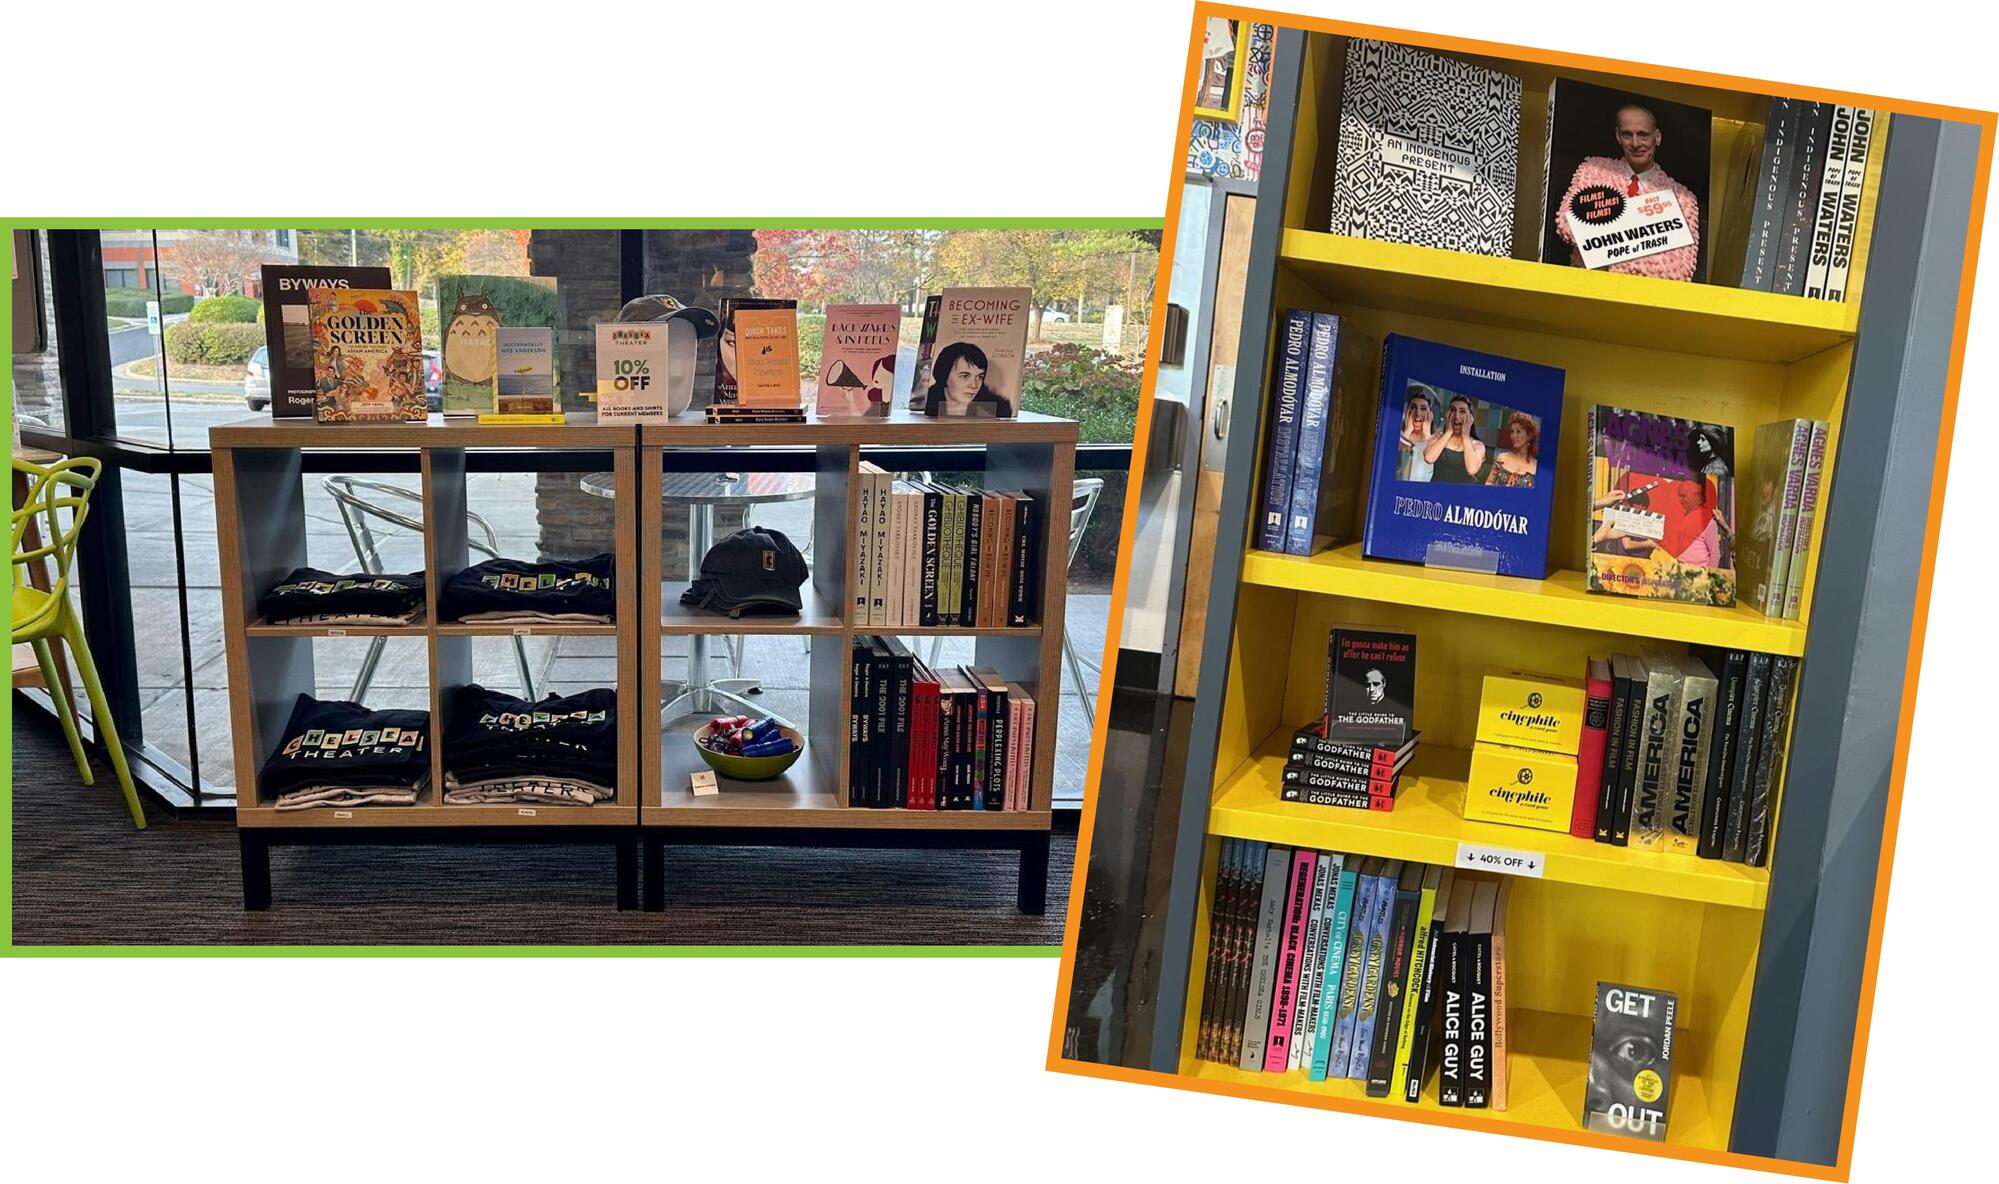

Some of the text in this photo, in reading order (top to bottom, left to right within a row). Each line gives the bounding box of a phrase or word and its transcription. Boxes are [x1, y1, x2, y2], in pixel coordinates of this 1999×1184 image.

[1388, 139, 1472, 166] AN INDIGENOUS
[1402, 154, 1455, 174] PRESENT
[1580, 192, 1604, 204] FILMS!
[1812, 108, 1850, 266] JOHN WATERS
[1832, 109, 1870, 269] JOHN WATERS
[1586, 209, 1611, 220] FILMS!
[1594, 198, 1619, 209] FILMS!
[1755, 121, 1784, 284] INDIGENOUS PRESENT
[1784, 128, 1814, 291] INDIGENOUS PRESENT
[1582, 218, 1683, 252] JOHN WATERS
[1607, 236, 1668, 258] POPE TRASH
[279, 278, 349, 290] BYWAYS
[949, 300, 1021, 312] BECOMING
[962, 314, 1014, 325] EX-WIFE
[328, 316, 403, 330] GOLDEN
[330, 330, 402, 344] SCREEN
[1287, 320, 1304, 354] PEDRO
[614, 360, 650, 374] 10%
[1306, 323, 1331, 427] PEDRO ALMODÓVAR
[1460, 365, 1506, 382] INSTALLATION
[614, 376, 650, 391] OFF
[1280, 358, 1300, 423] ALMODÓVAR
[288, 396, 314, 405] Roger
[1784, 468, 1802, 509] VARDA
[1802, 470, 1820, 513] VARDA
[971, 504, 980, 537] NOBODY'S
[1394, 496, 1528, 535] PEDRO ALMODÓVAR
[926, 509, 938, 555] GOLDEN
[941, 500, 953, 569] GHIBLIOTHEQUE
[953, 500, 966, 569] GHIBLIOTHEQUE
[859, 531, 867, 586] MIYAZAKI
[877, 531, 885, 586] MIYAZAKI
[924, 557, 936, 599] SCREEN
[1602, 573, 1640, 588] DIRECTOR'S
[1344, 649, 1360, 658] offer
[1361, 651, 1369, 659] he
[1351, 640, 1370, 649] gonna
[1389, 642, 1400, 650] him
[879, 696, 887, 716] 2001
[1726, 676, 1738, 726] Vampire Cinema
[1356, 716, 1404, 725] GODFATHER
[1500, 710, 1560, 728] cinephile
[1749, 706, 1757, 729] Cinema
[283, 728, 419, 754] CHELSEA
[942, 737, 950, 751] May
[1608, 697, 1625, 769] FASHION IN FILM
[1625, 699, 1642, 770] FASHION IN FILM
[291, 747, 402, 759] THEATER
[939, 751, 949, 770] Wong
[993, 720, 1003, 792] PERPLEXING PLOTS
[1317, 743, 1371, 760] GODFATHER
[1638, 694, 1672, 828] AMERICA
[1672, 697, 1704, 834] AMERICA
[1314, 759, 1369, 776] GODFATHER
[1309, 776, 1366, 792] GODFATHER
[1489, 787, 1551, 804] cinephile
[1310, 794, 1368, 808] GODFATHER
[1480, 854, 1523, 867] 40% OFF
[1268, 899, 1276, 916] Andy
[1292, 862, 1308, 924] REGENERATION:
[1288, 925, 1299, 951] BLACK
[1295, 864, 1326, 1036] JONAS MEKAS CONVERSATIONS WITH FILM-MAKERS
[1308, 863, 1339, 1033] JONAS MEKAS CONVERSATIONS WITH FILM-MAKERS
[1284, 952, 1296, 984] CINEMA
[1325, 911, 1346, 1009] CITY CINEMA PARIS
[1394, 957, 1403, 978] MOVIES
[1411, 926, 1427, 993] alfred HITCHCOCK
[1255, 1000, 1264, 1020] GIRLS
[1495, 943, 1504, 1048] Bollywood Superstars
[1606, 989, 1655, 1018] GET
[1444, 990, 1460, 1039] ALICE
[1471, 992, 1485, 1041] ALICE
[1662, 1000, 1674, 1060] JORDAN PEELE
[1443, 1043, 1459, 1079] GUY
[1470, 1044, 1484, 1081] GUY
[1608, 1103, 1663, 1136] OUT
